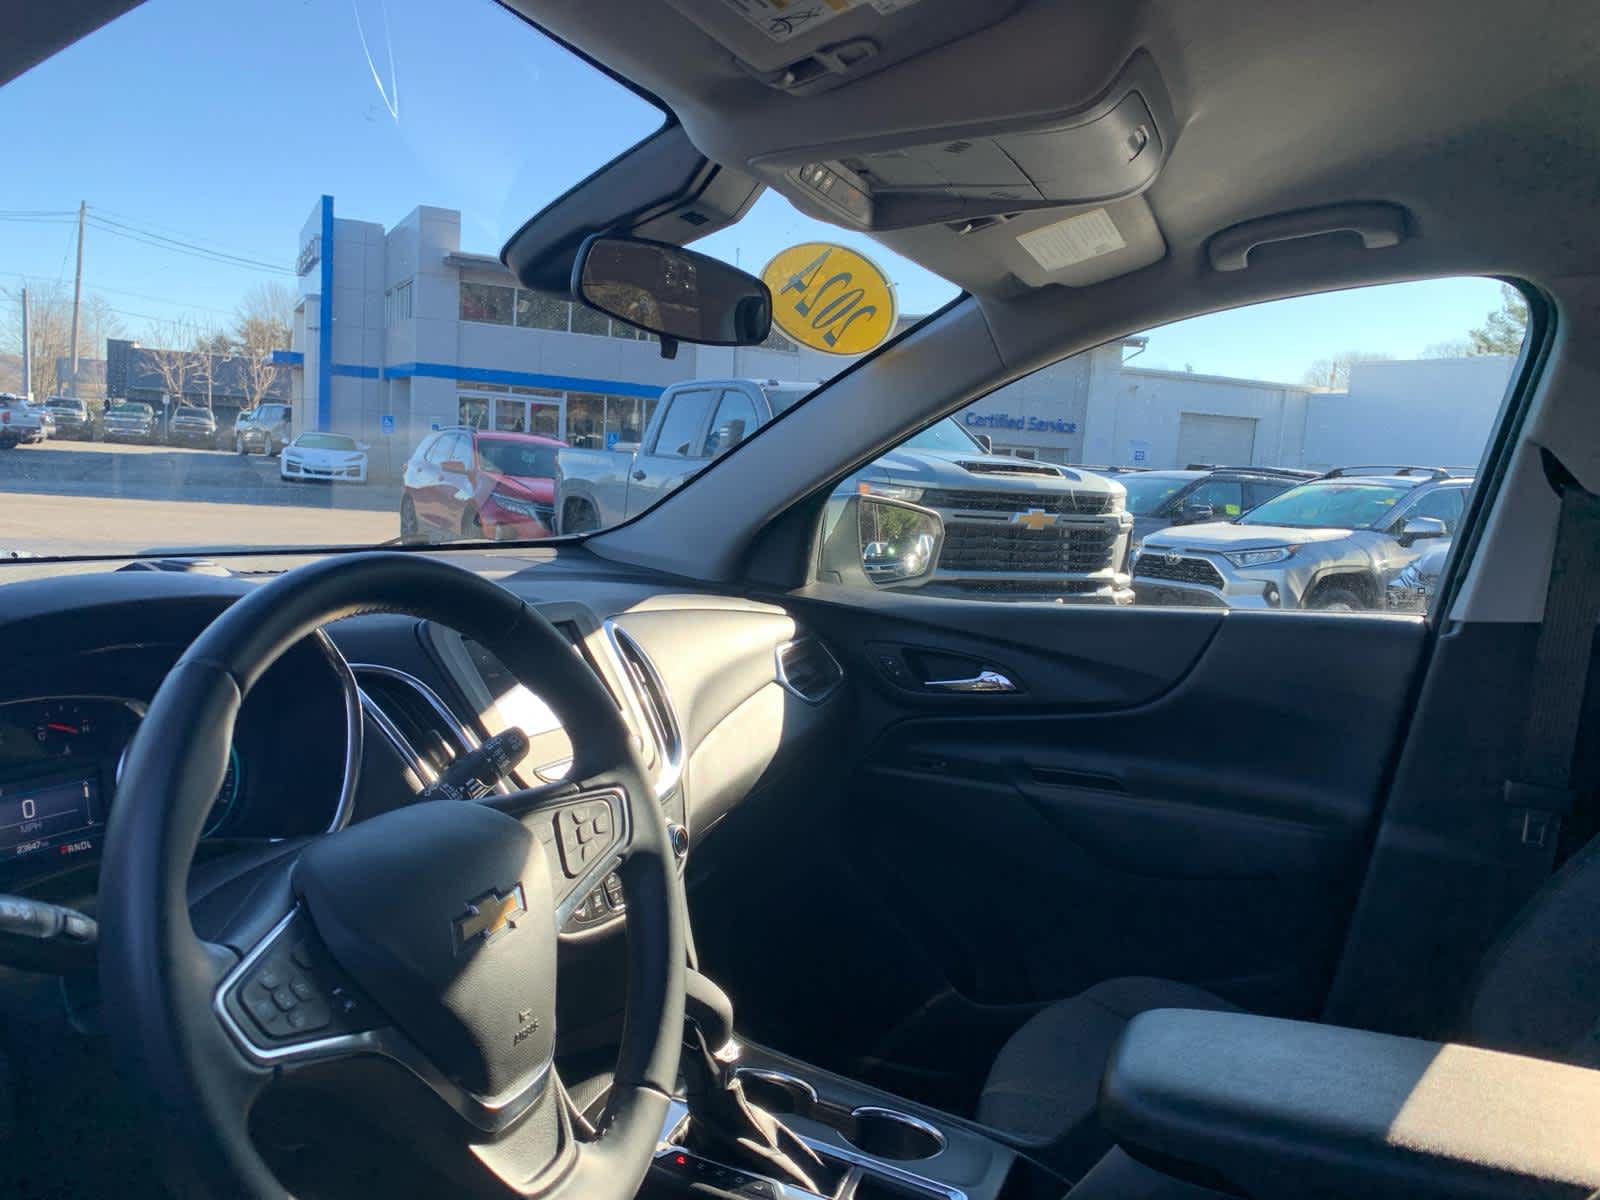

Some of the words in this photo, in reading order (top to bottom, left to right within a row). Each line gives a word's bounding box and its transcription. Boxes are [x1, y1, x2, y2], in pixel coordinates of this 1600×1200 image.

[966, 412, 1025, 431] Certified
[1027, 415, 1077, 434] Service
[22, 799, 36, 819] 0
